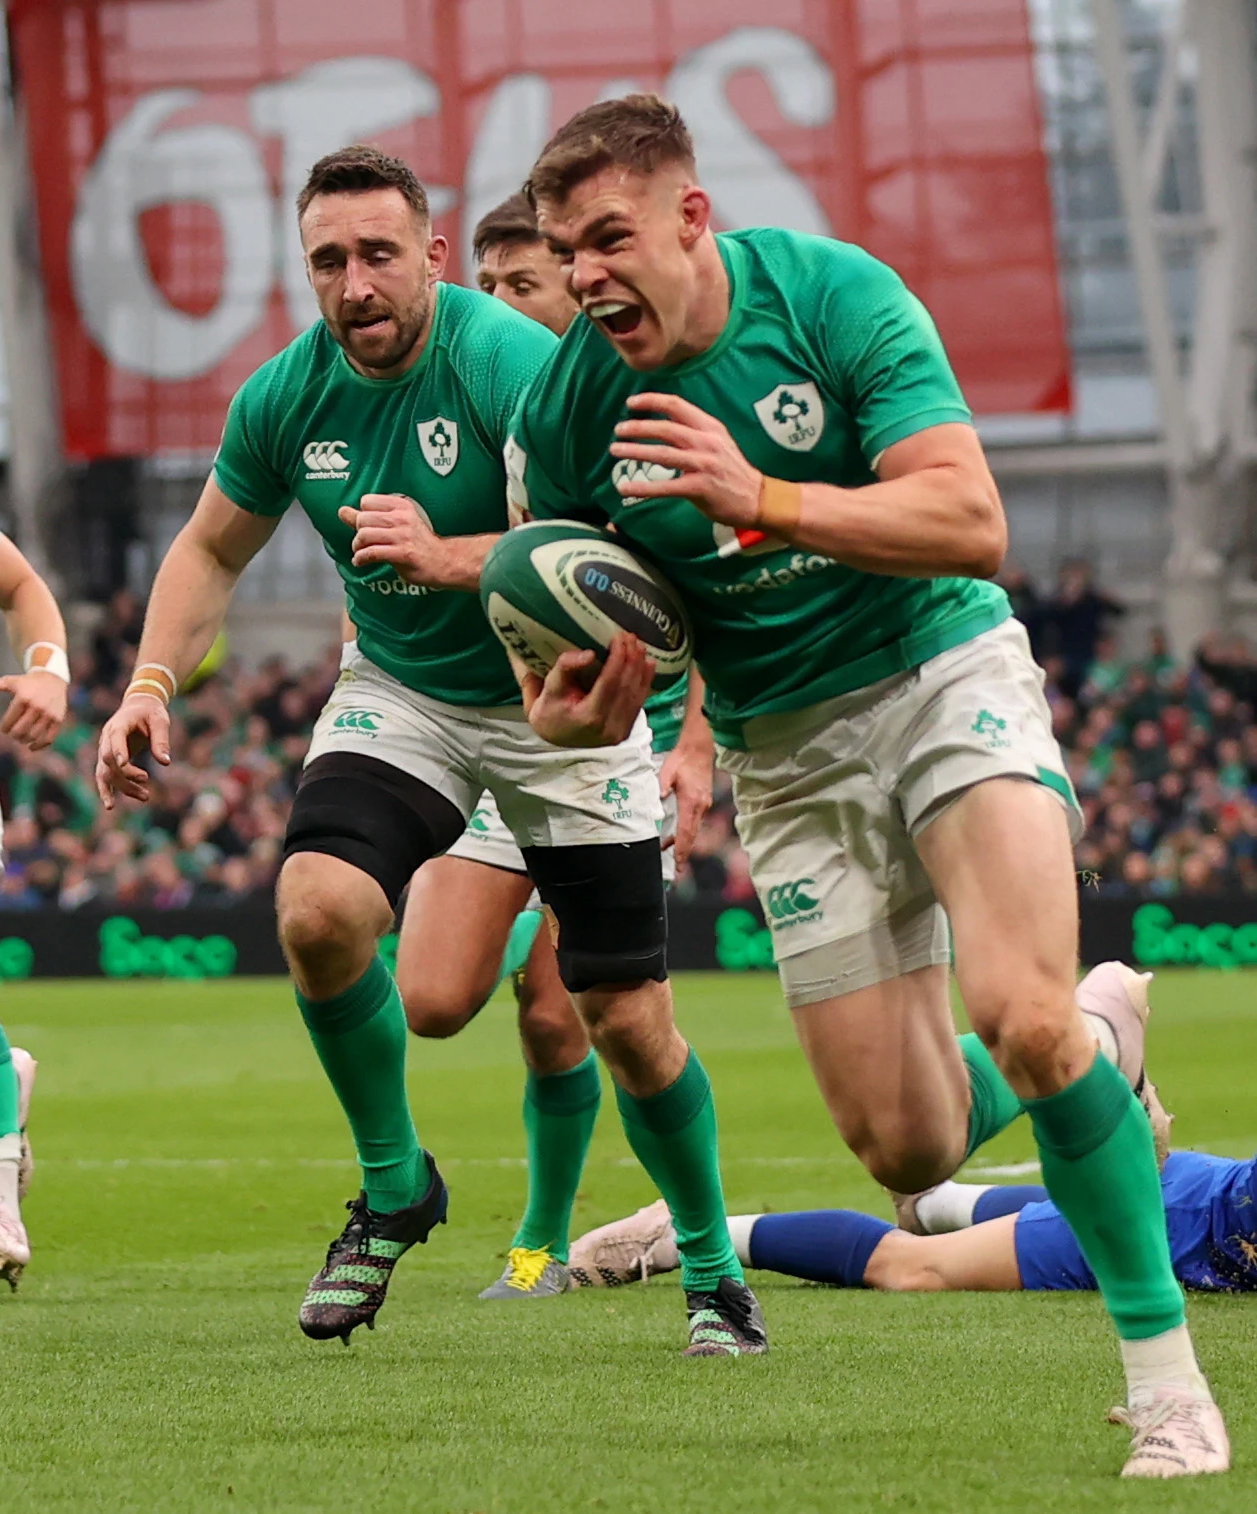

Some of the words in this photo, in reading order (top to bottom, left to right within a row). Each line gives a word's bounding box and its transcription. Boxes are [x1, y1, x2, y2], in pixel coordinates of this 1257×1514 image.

[305, 470, 350, 481] canterbury
[583, 567, 610, 592] 0.0
[609, 579, 672, 631] GUINNESS
